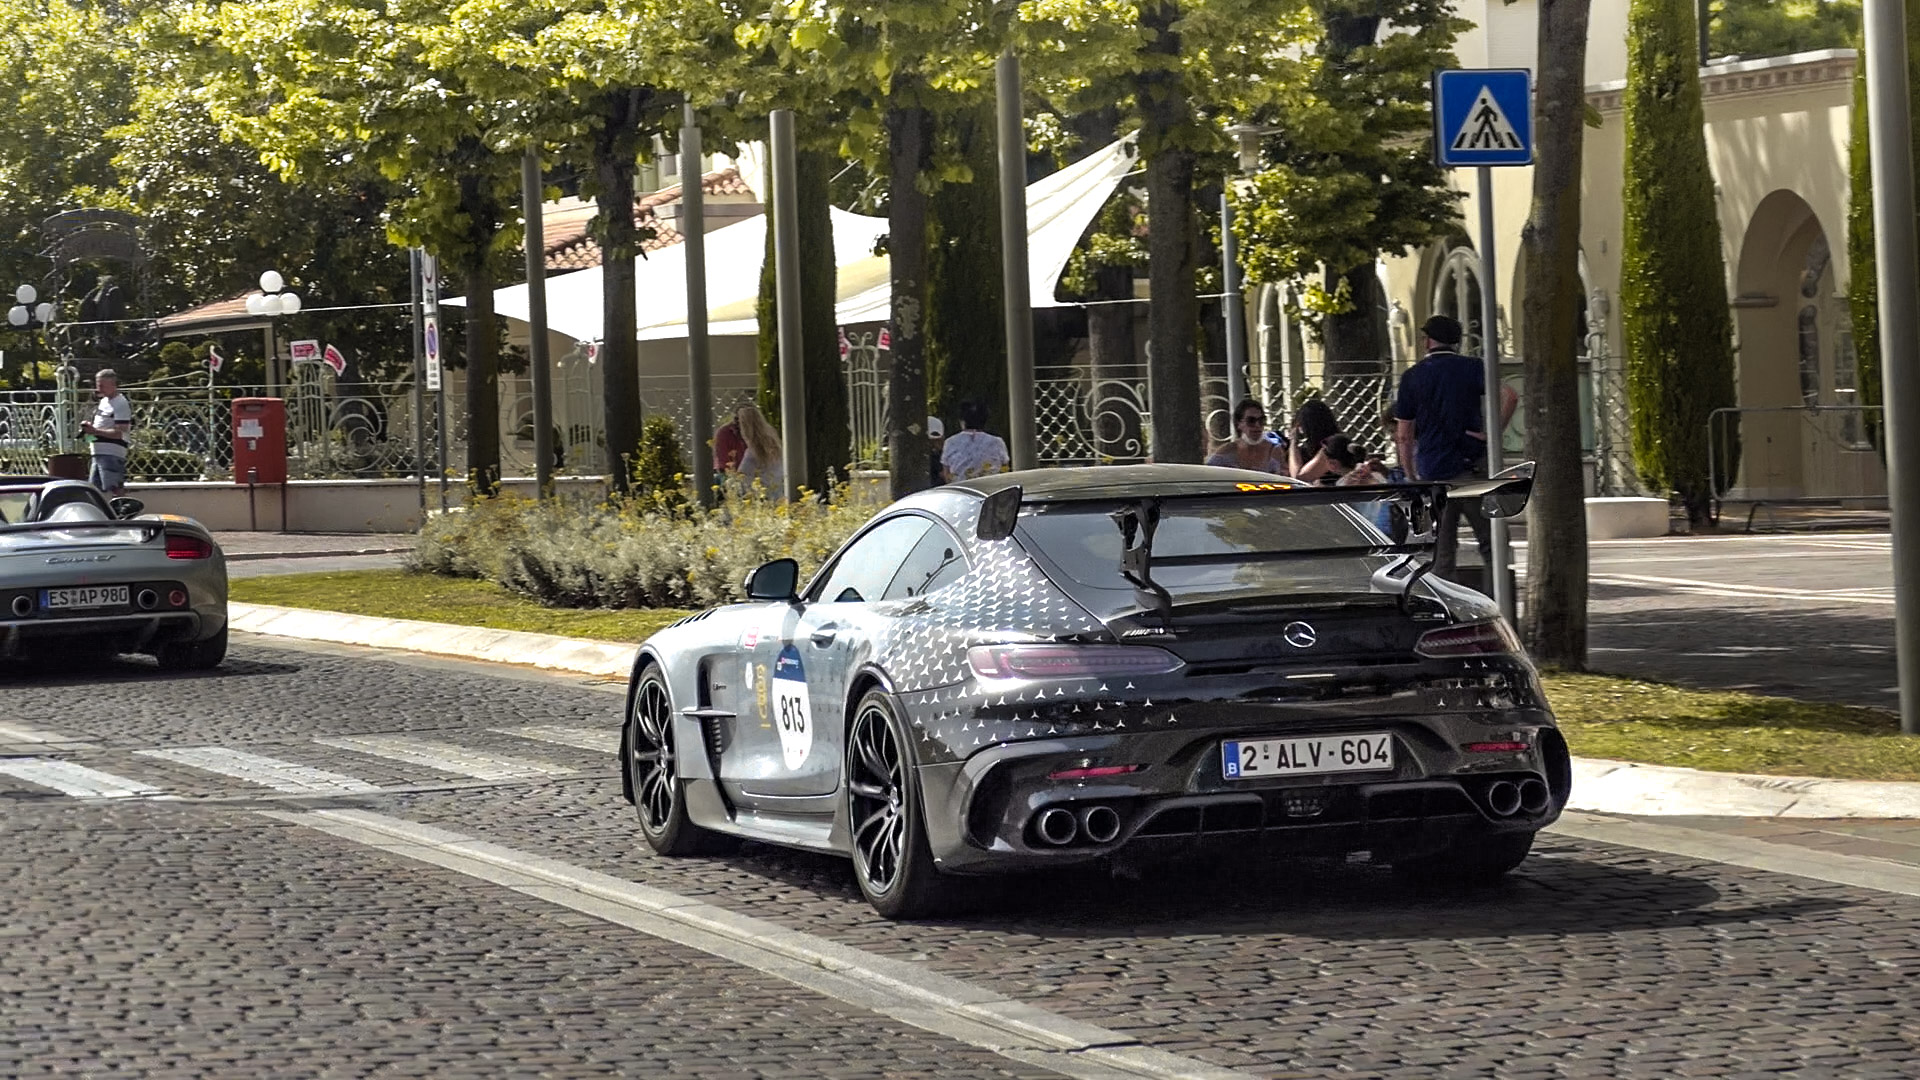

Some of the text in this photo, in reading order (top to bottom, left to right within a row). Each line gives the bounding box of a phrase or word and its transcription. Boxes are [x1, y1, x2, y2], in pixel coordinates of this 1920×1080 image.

[49, 587, 128, 606] ES AP 980
[781, 694, 805, 733] 813
[1227, 762, 1238, 775] B
